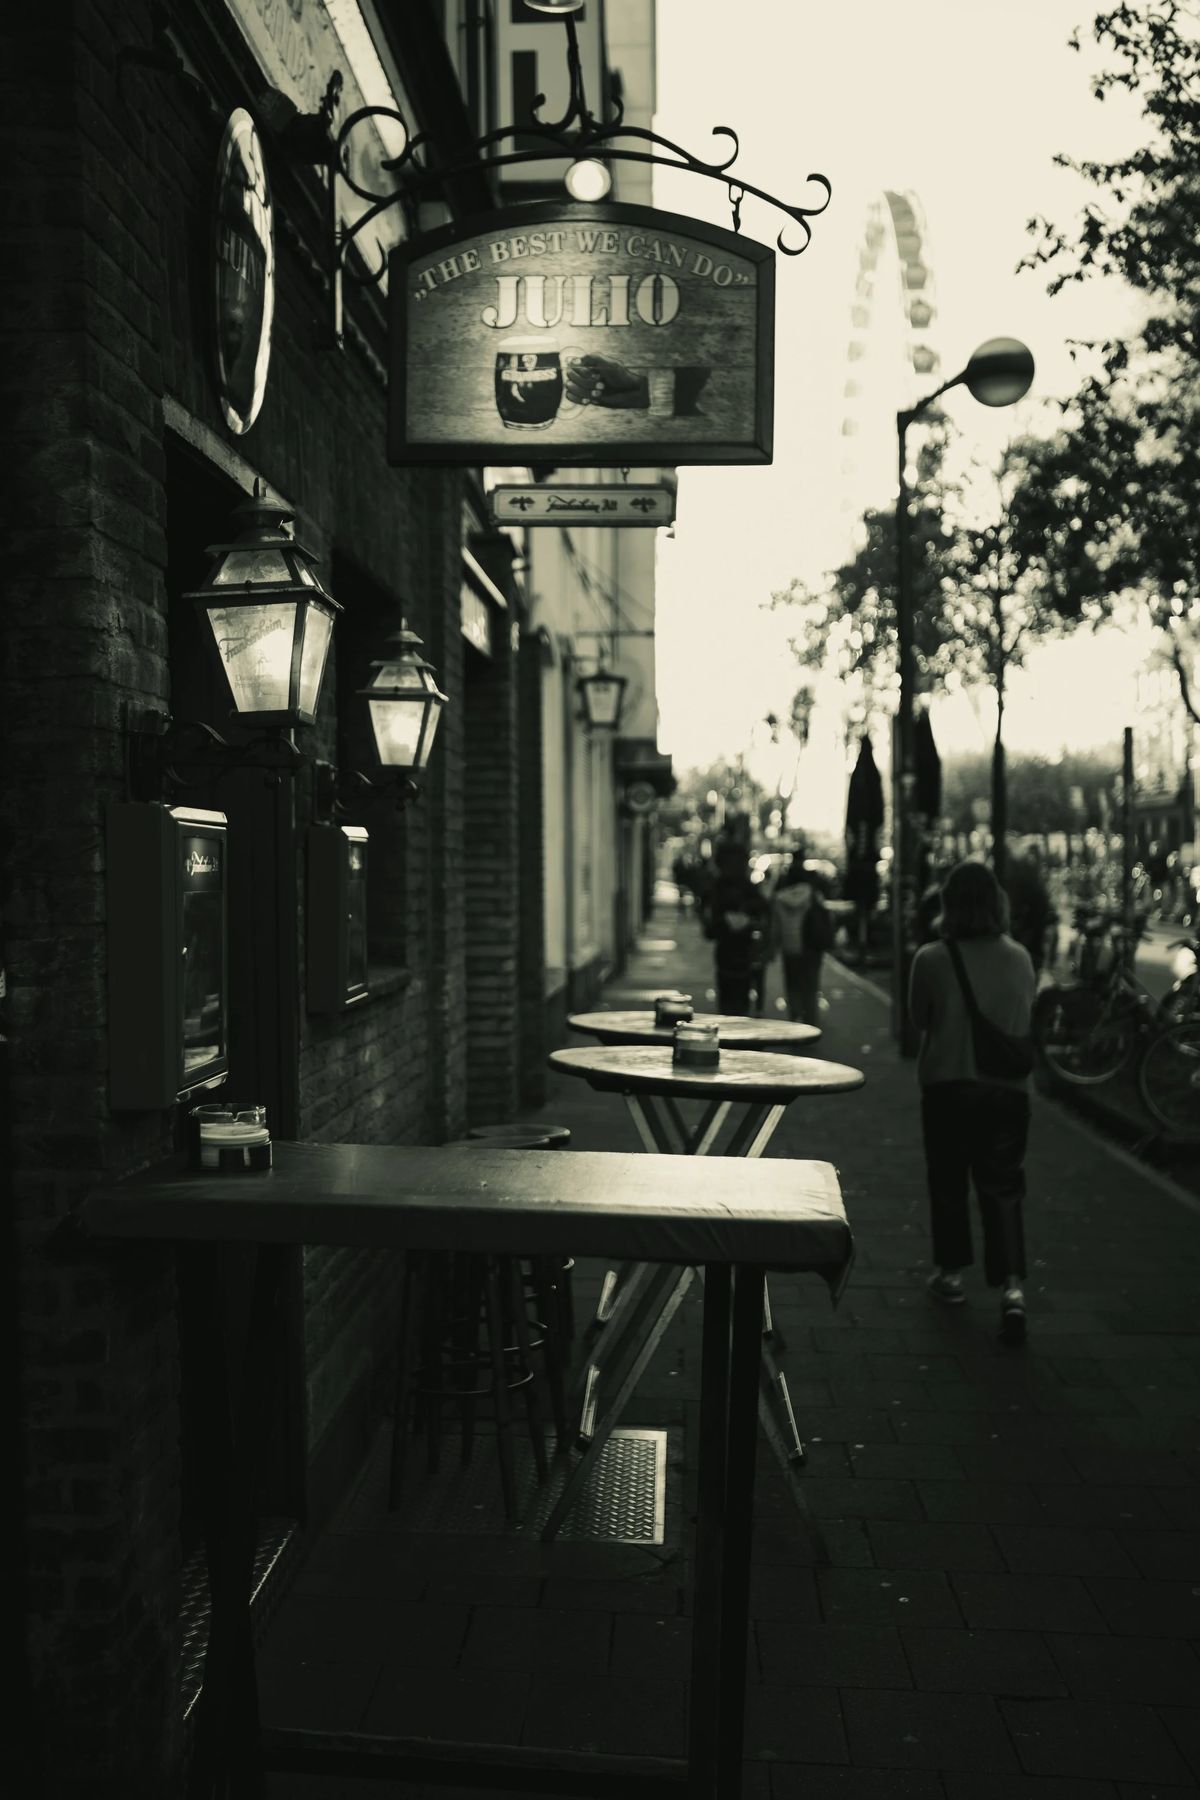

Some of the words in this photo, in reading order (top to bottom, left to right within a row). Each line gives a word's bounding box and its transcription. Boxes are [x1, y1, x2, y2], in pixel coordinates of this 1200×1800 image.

[489, 231, 567, 264] BEST
[575, 229, 619, 254] WE
[626, 235, 687, 268] CAN
[480, 273, 680, 329] JULIO
